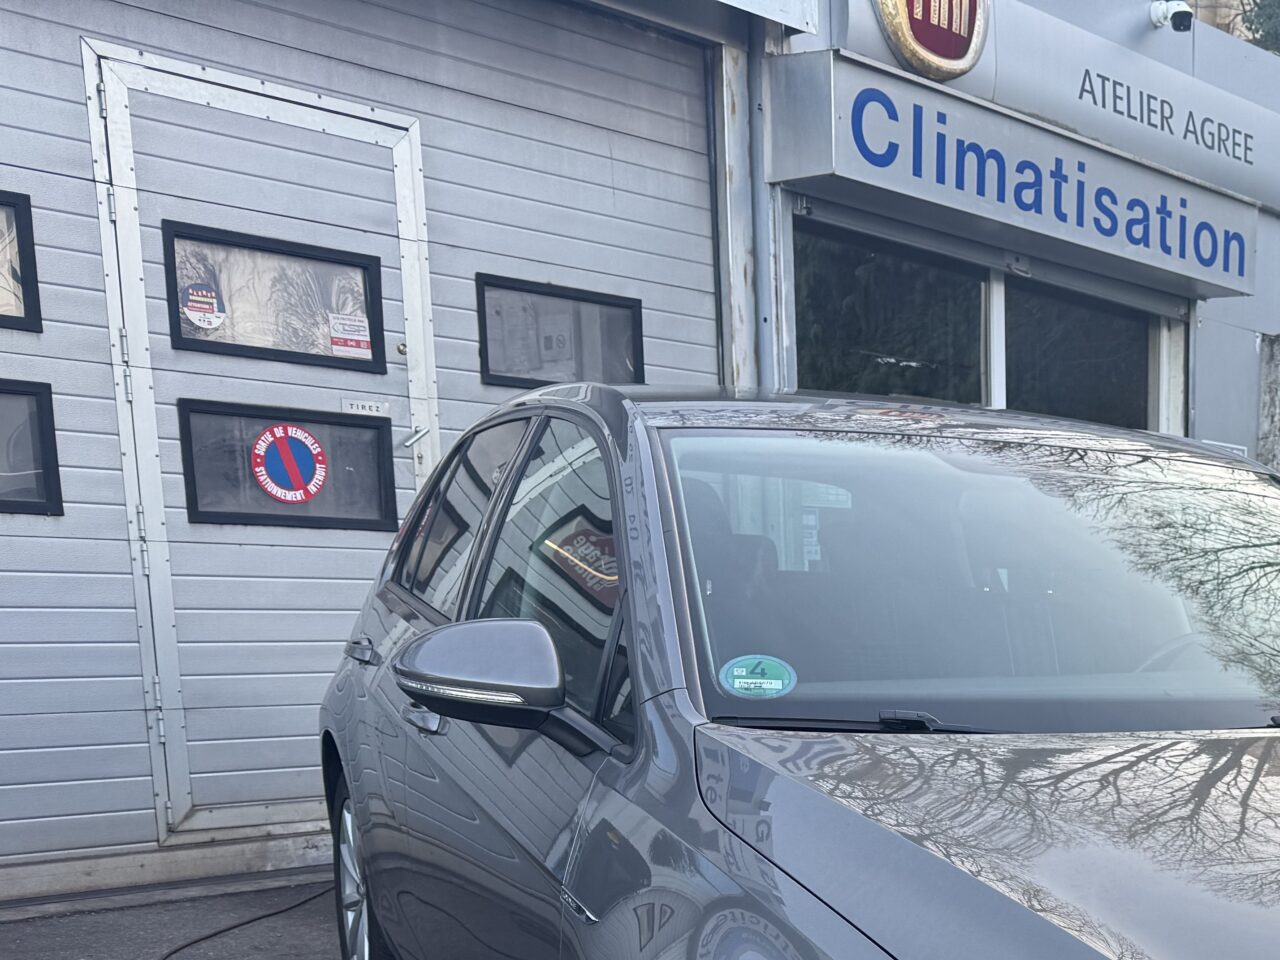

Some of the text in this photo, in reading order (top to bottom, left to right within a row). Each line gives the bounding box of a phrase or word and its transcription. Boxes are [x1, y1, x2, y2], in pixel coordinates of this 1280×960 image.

[1078, 69, 1254, 165] ATELIER AGREE
[851, 87, 1247, 278] Climatisation
[349, 403, 380, 412] TIREZ
[254, 426, 322, 456] SORTIE DE VEHICULES
[254, 463, 327, 501] STATIONNEMENT INTERDIT
[749, 660, 768, 678] 4
